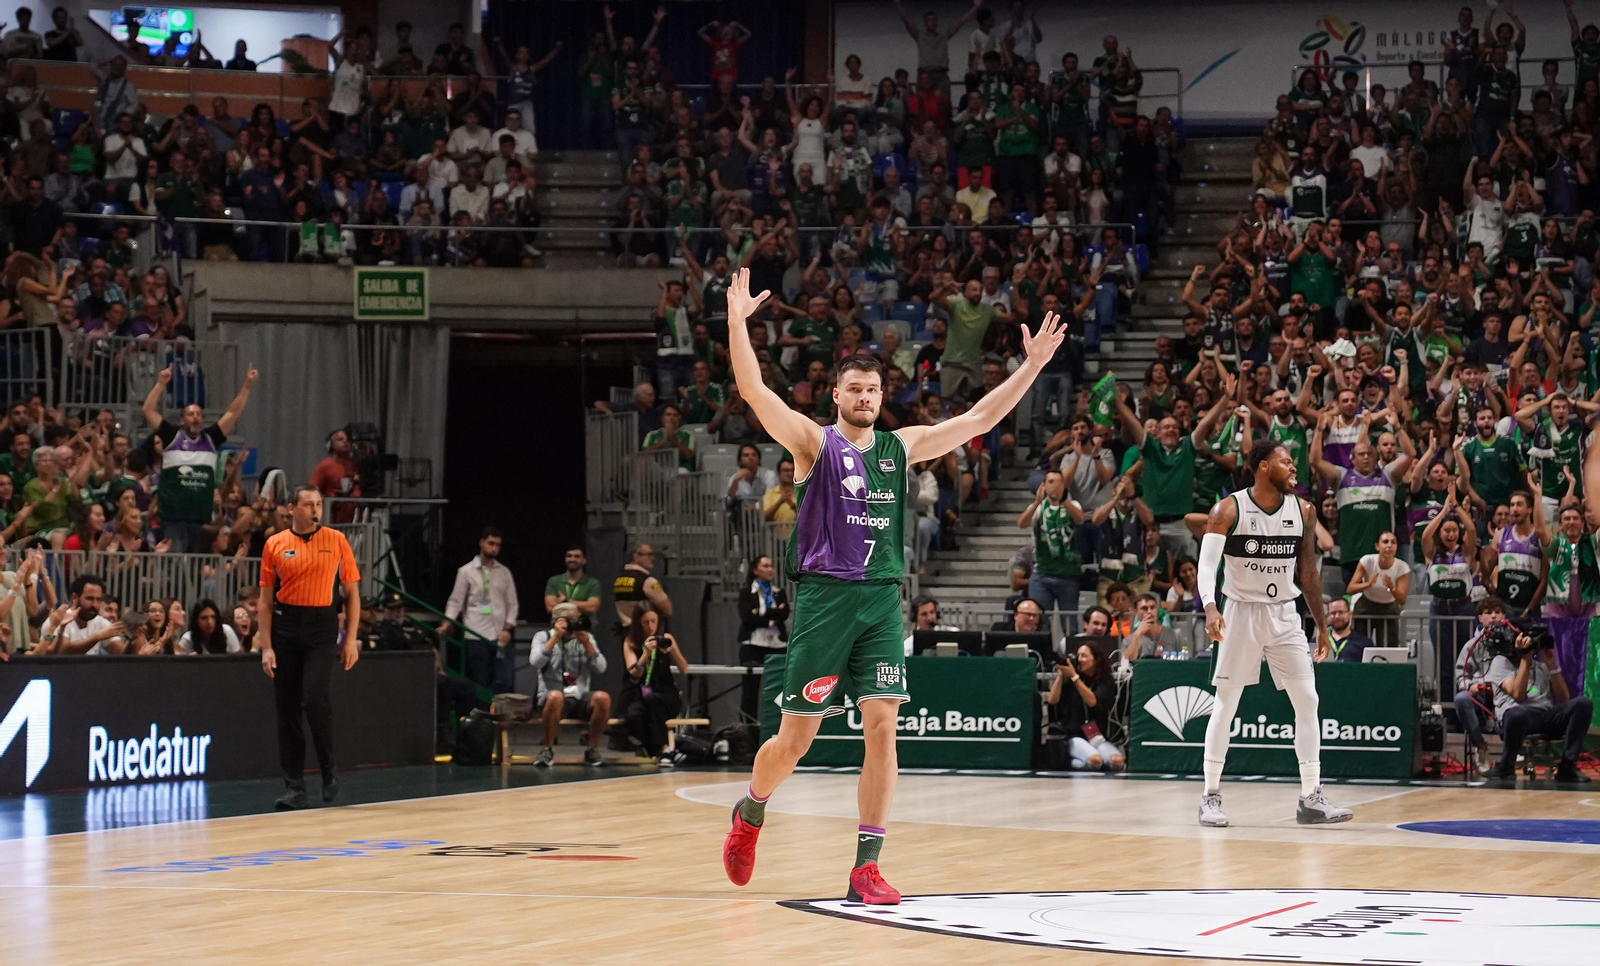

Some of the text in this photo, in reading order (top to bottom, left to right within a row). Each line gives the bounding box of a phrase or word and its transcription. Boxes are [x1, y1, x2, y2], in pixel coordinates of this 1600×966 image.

[1417, 50, 1444, 60] Evento
[363, 278, 419, 293] SALIDA DE
[359, 295, 422, 310] EMERGENCIA
[866, 489, 895, 500] Unicaja
[863, 539, 876, 566] 7
[1244, 561, 1288, 574] JOVENT
[1266, 582, 1278, 598] 0
[1508, 584, 1520, 599] 9
[847, 707, 1021, 736] Ucaja Banco
[1230, 714, 1402, 741] Unica Banco
[88, 722, 212, 782] Ruedatur
